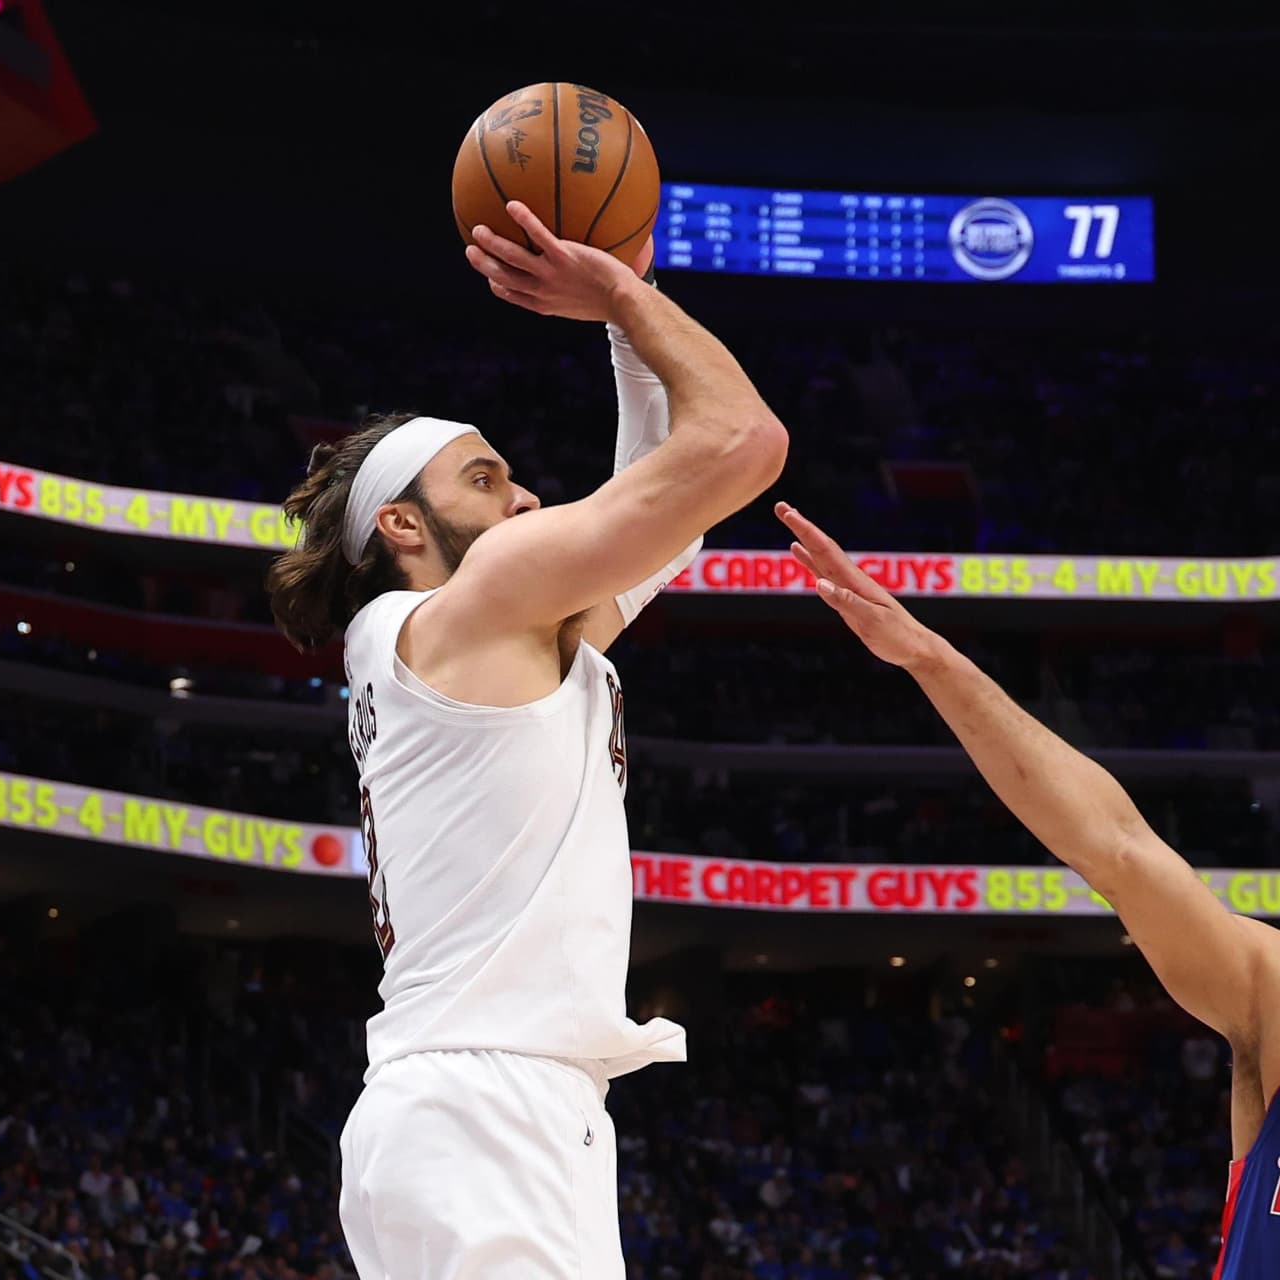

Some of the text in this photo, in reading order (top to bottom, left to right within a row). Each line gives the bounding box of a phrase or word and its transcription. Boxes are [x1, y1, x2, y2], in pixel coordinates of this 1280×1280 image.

[572, 84, 613, 174] ilson
[1063, 205, 1120, 258] 77
[39, 478, 304, 548] 855-4-MY-GU
[857, 554, 955, 595] GUYS
[960, 557, 1277, 598] 855-4-MY-GUYS
[631, 853, 694, 902] THE
[699, 860, 859, 911] CARPET
[865, 867, 980, 912] GUYS
